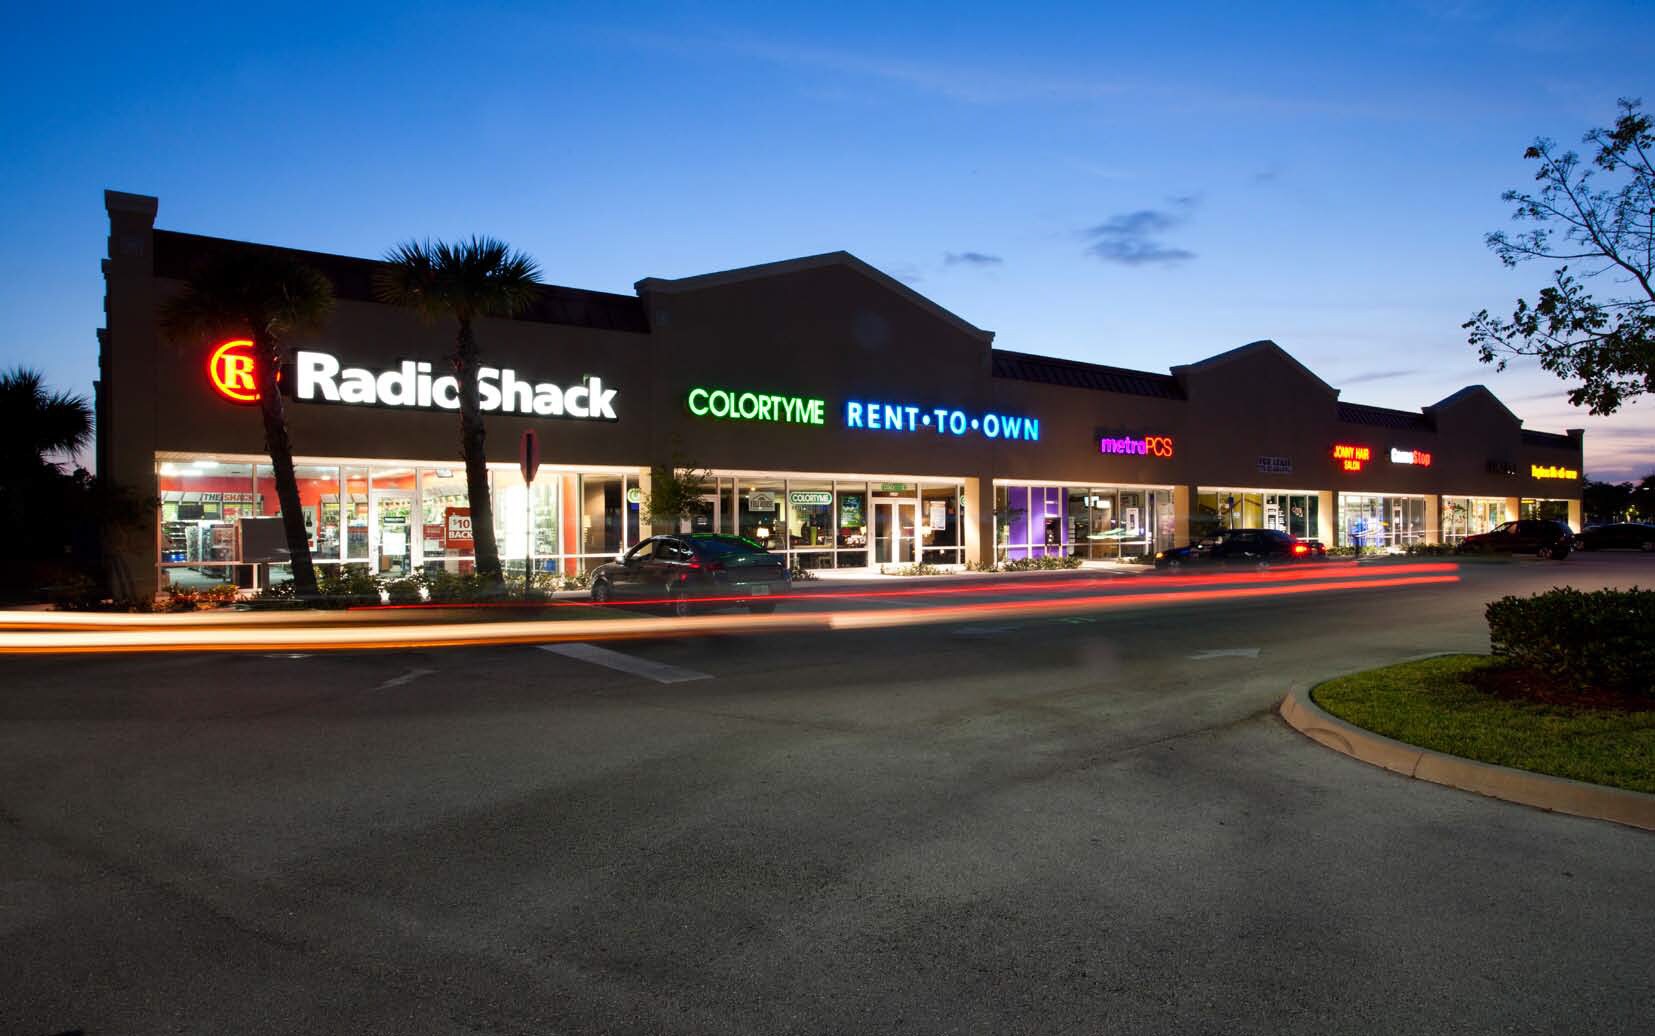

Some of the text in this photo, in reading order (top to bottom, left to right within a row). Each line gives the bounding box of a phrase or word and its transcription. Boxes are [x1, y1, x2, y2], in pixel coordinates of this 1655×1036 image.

[297, 351, 617, 419] RadioShack
[689, 388, 825, 425] COLORTYME
[1101, 436, 1173, 457] metroPCS
[1344, 460, 1361, 470] SALON
[448, 531, 473, 539] BACK
